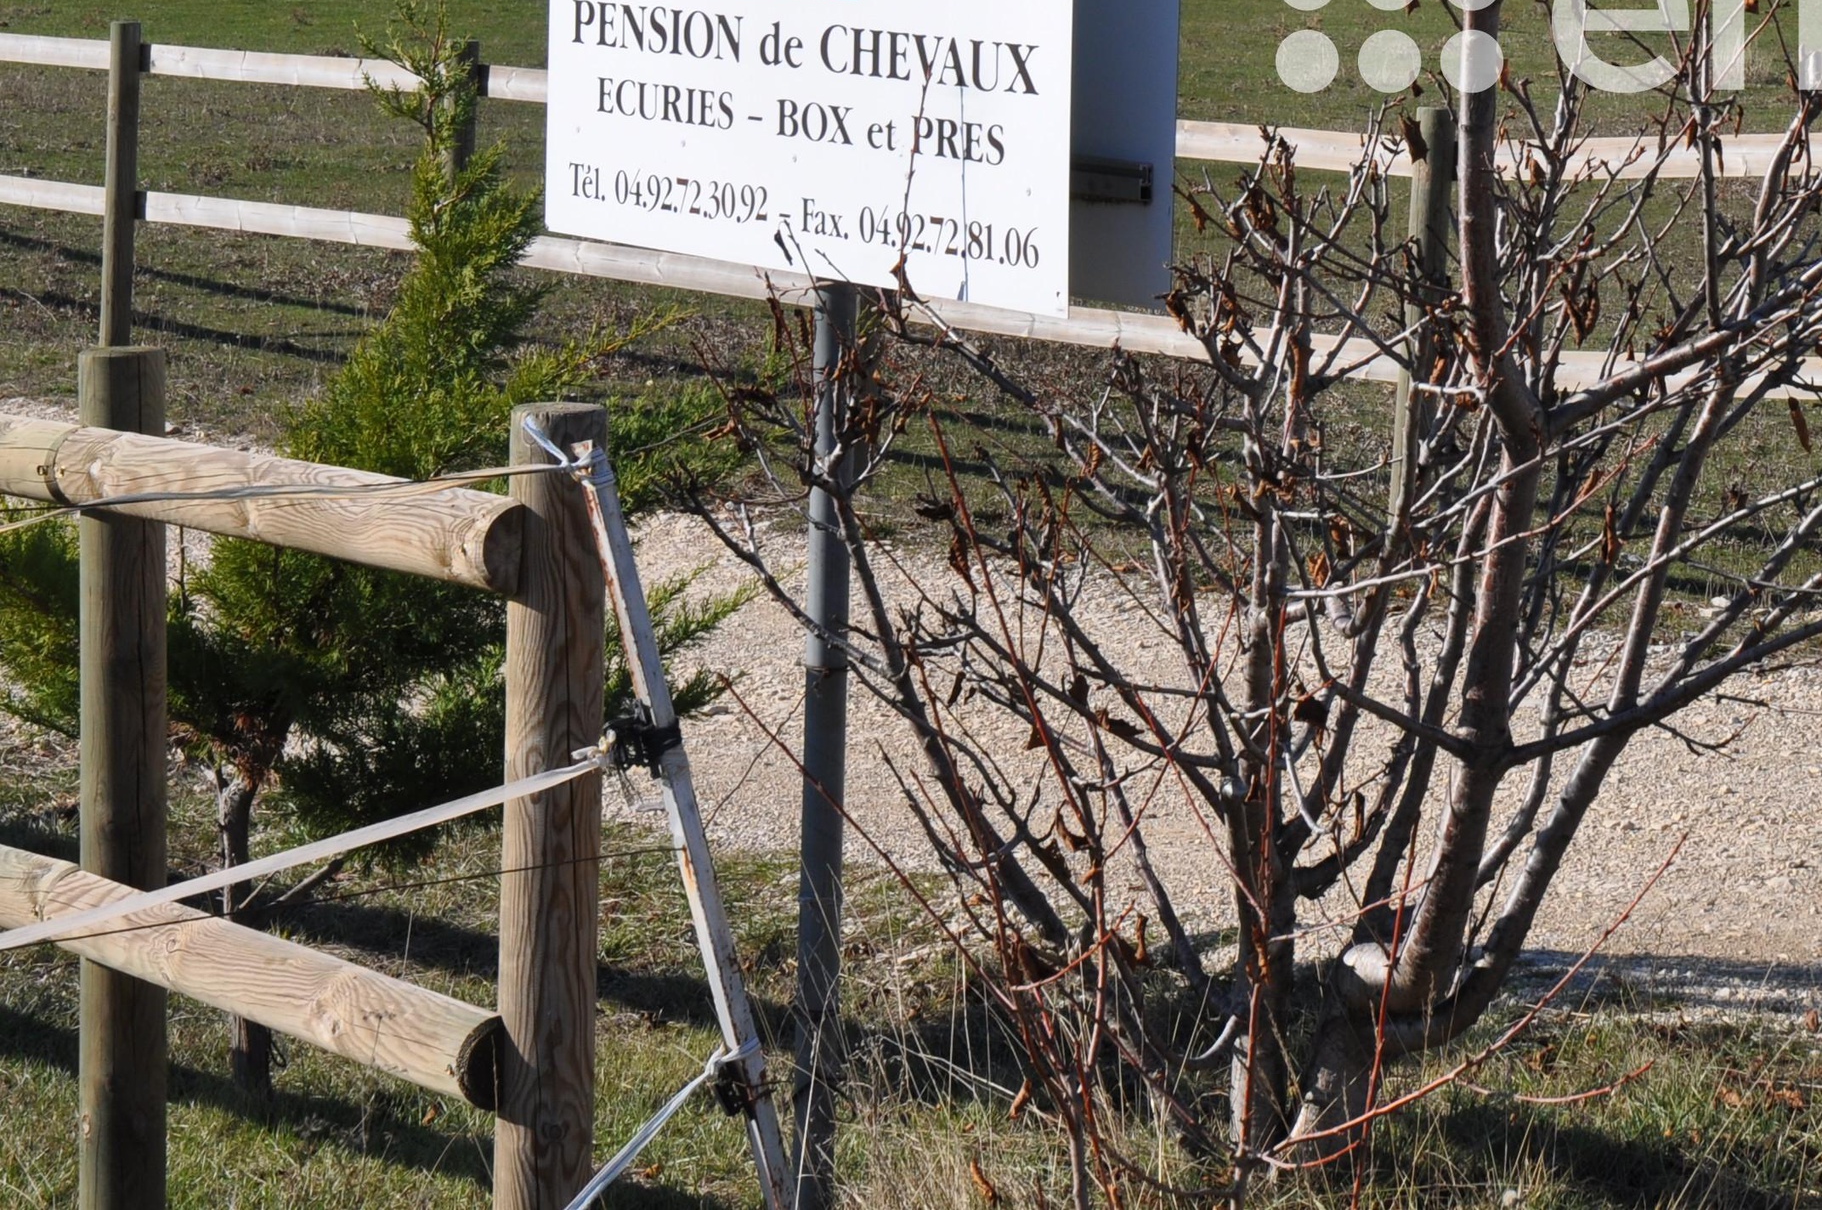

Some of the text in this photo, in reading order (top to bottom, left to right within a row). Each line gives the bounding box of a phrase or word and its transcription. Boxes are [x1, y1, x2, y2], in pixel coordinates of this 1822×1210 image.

[571, 0, 1040, 95] PENSION de CHEVAUX
[596, 76, 734, 130] ECURIES
[777, 98, 854, 146] BOX
[866, 122, 897, 152] et
[911, 115, 1006, 166] PRES
[568, 162, 606, 203] Tél.
[614, 168, 768, 224] 04.92.72.30.92
[801, 196, 849, 240] Fax.
[859, 204, 1040, 269] 04.92.72.81.06
